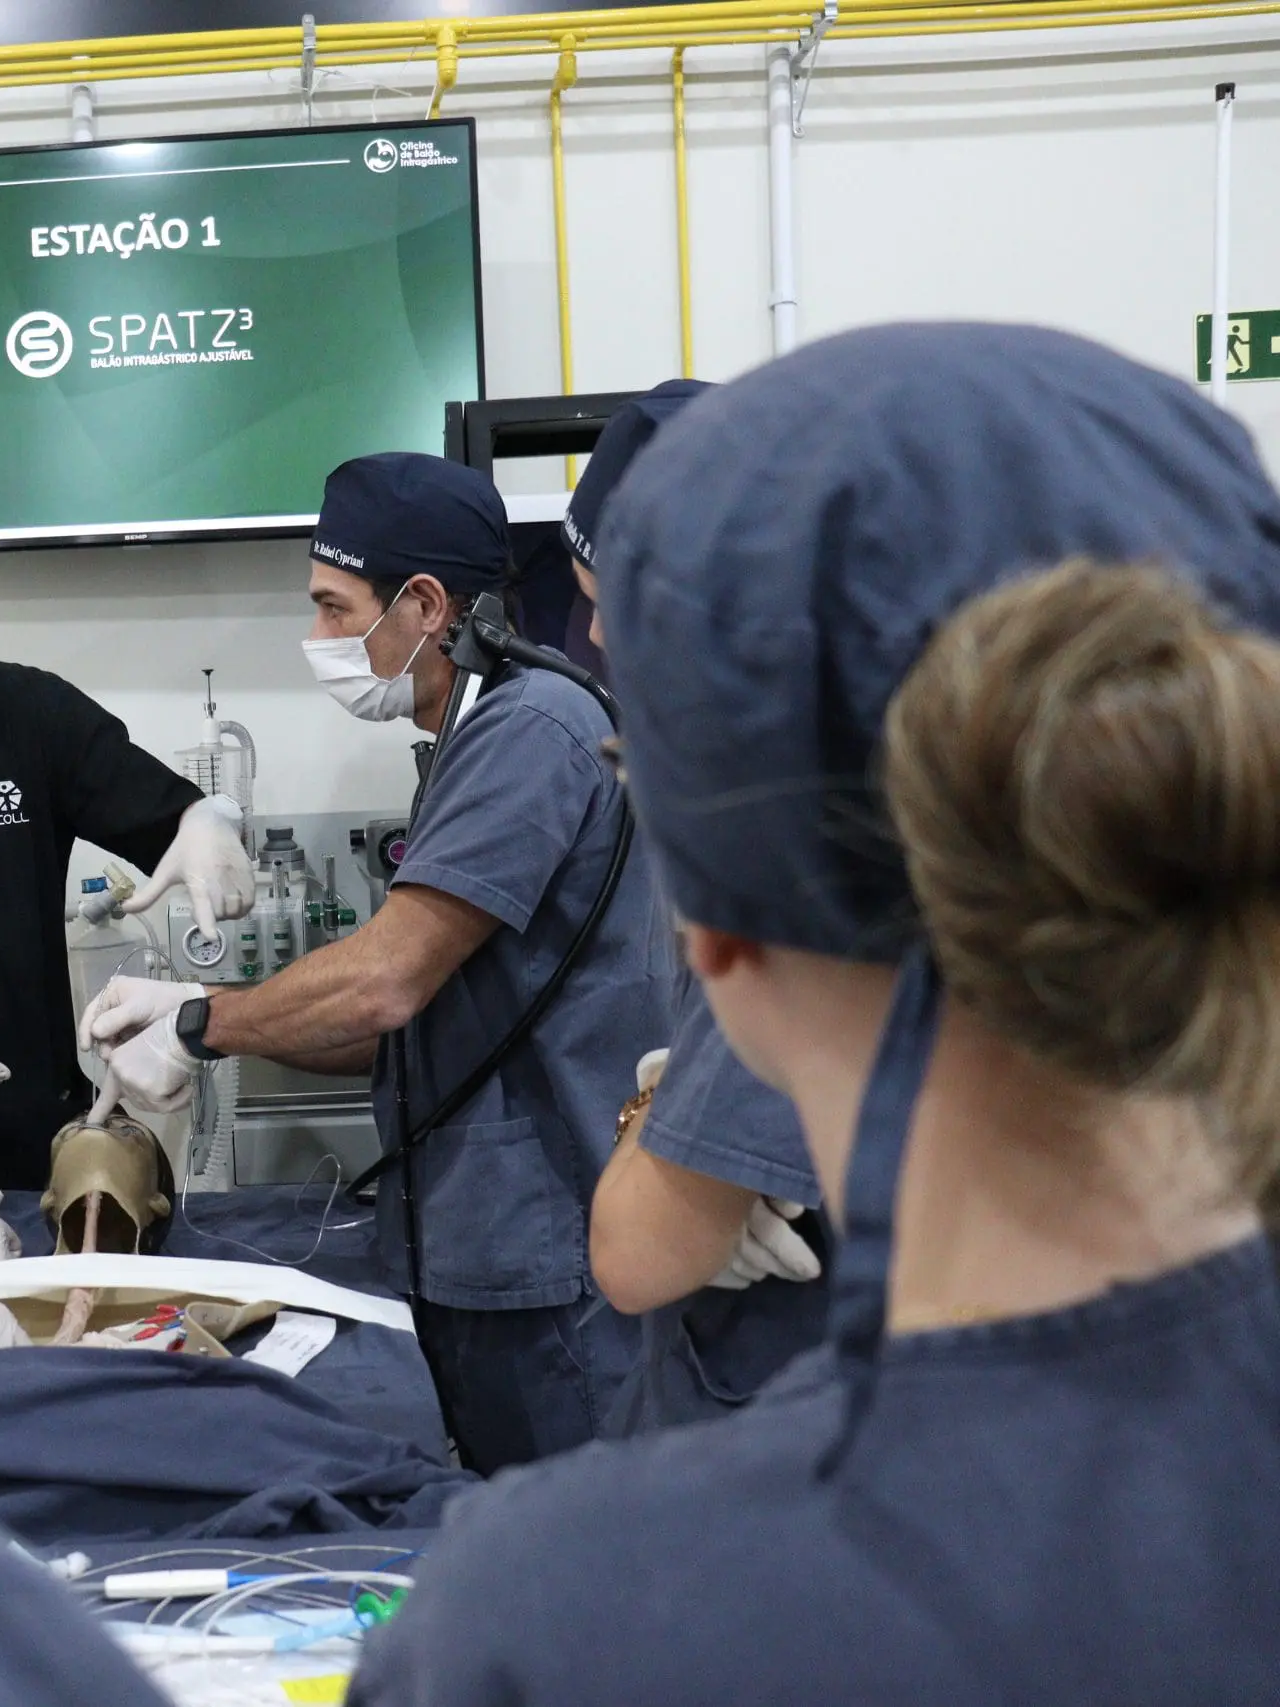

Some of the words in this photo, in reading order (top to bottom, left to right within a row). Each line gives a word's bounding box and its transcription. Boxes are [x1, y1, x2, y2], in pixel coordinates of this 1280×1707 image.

[400, 141, 434, 151] Oficina
[31, 213, 189, 259] ESTAÇÃO
[201, 216, 221, 247] 1
[91, 354, 121, 369] BALÃO
[124, 351, 197, 367] INTRAGÁSTRICO
[199, 348, 254, 362] AJUSTÁVEL
[335, 549, 365, 569] Cypriani
